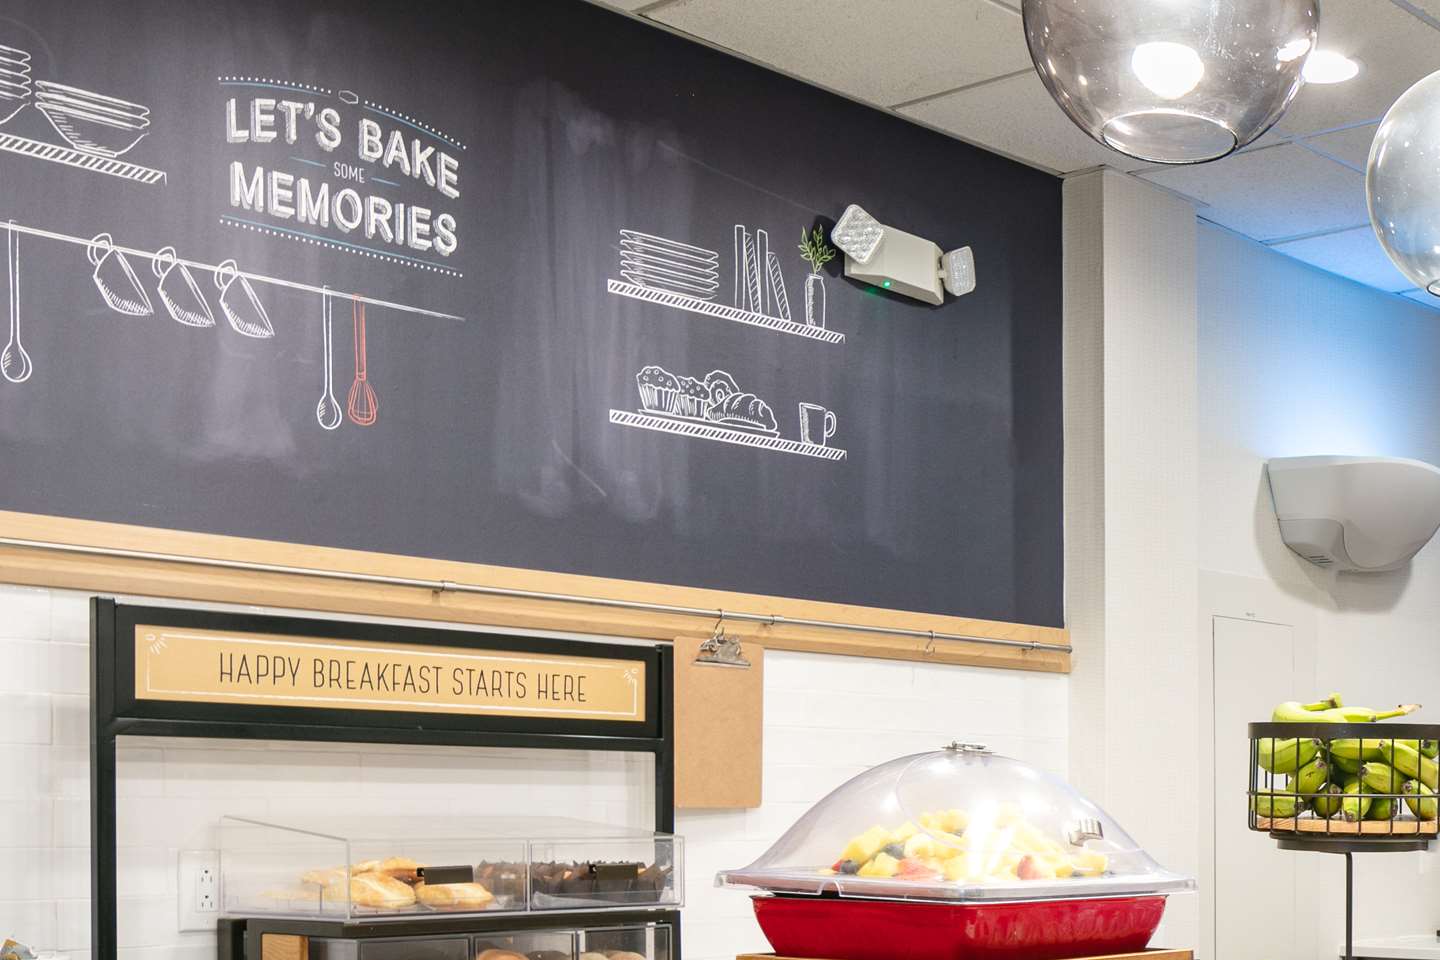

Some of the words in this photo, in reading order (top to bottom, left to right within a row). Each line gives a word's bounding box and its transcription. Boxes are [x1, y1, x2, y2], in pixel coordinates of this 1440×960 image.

[227, 98, 342, 152] LET'S
[358, 117, 460, 199] BAKE
[333, 162, 365, 183] SOME
[230, 160, 458, 257] MEMORIES
[219, 652, 301, 688] HAPPY
[312, 658, 443, 695] BREAKFAST
[452, 667, 527, 700] STARTS
[537, 673, 588, 703] HERE
